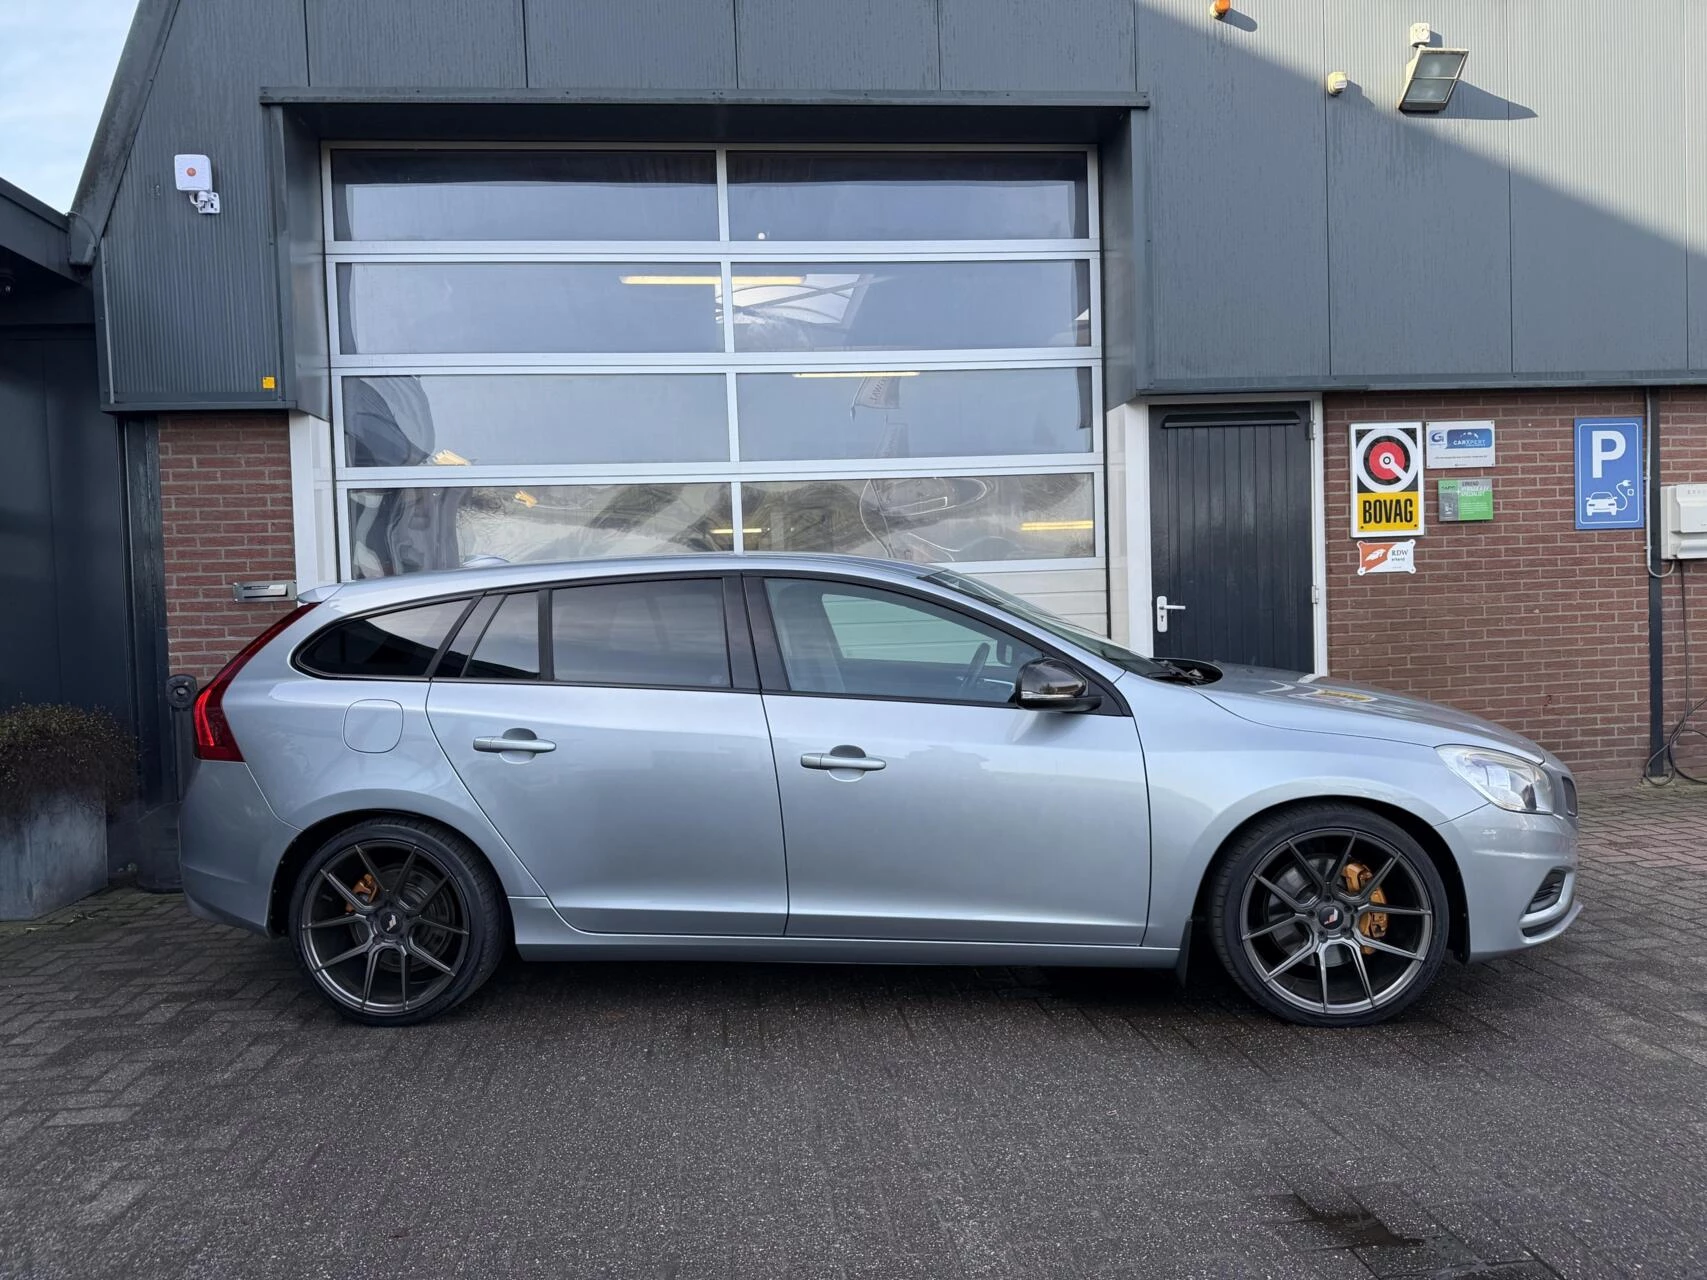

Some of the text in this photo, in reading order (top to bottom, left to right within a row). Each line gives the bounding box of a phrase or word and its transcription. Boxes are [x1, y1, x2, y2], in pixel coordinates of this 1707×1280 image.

[1592, 430, 1626, 478] P
[1362, 498, 1414, 525] BOVAG
[1391, 549, 1409, 557] RDW
